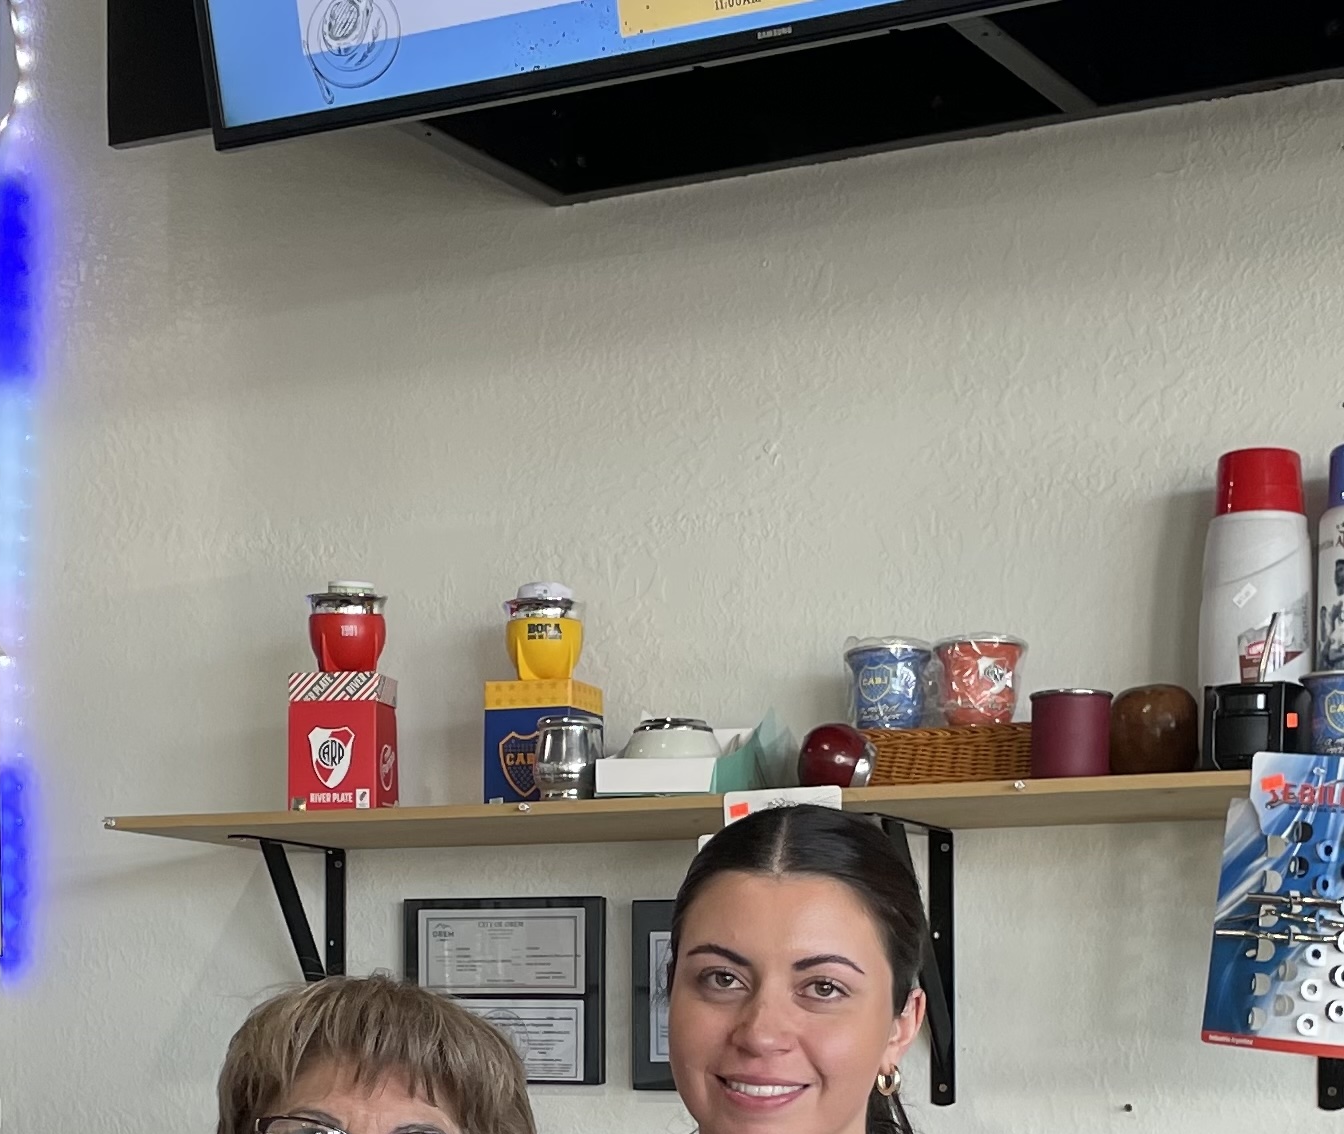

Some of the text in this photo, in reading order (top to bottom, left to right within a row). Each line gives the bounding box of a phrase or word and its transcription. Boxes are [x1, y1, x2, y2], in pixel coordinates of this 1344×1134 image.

[527, 623, 563, 636] BOCA
[310, 791, 354, 803] RIVER PLATE
